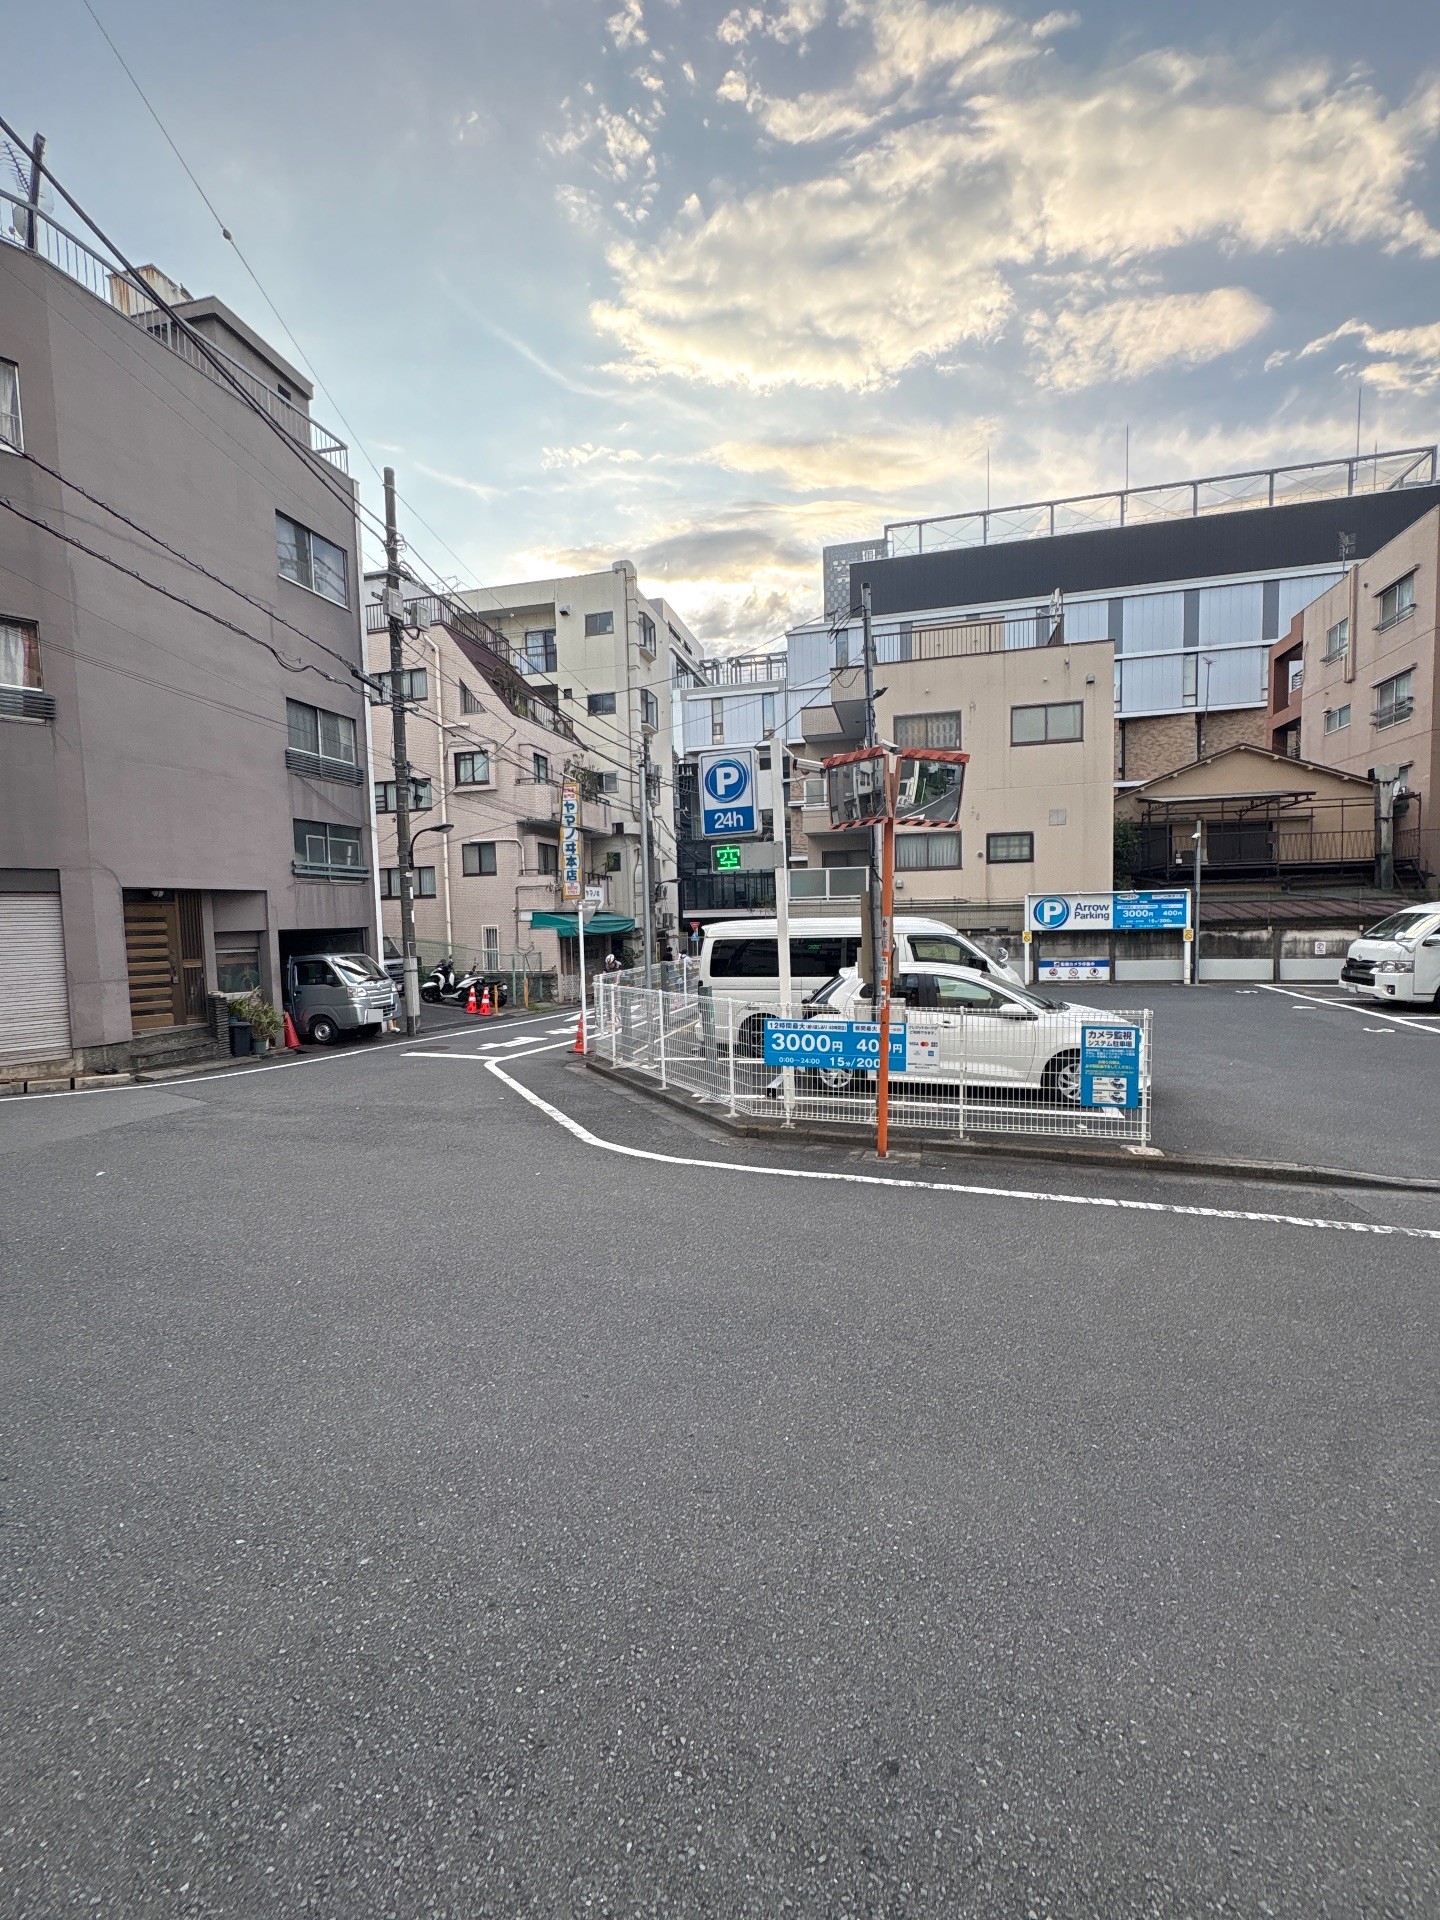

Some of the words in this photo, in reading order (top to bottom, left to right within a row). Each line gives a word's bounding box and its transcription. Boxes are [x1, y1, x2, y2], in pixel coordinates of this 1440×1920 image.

[714, 810, 744, 829] 24h
[716, 846, 741, 871] 空
[1074, 902, 1110, 912] Arrow
[1073, 911, 1110, 921] Parking
[1088, 1030, 1133, 1040] カメラ監視
[771, 1032, 843, 1053] 3000円
[856, 1038, 903, 1054] 40円
[1088, 1040, 1133, 1048] システム駐車場
